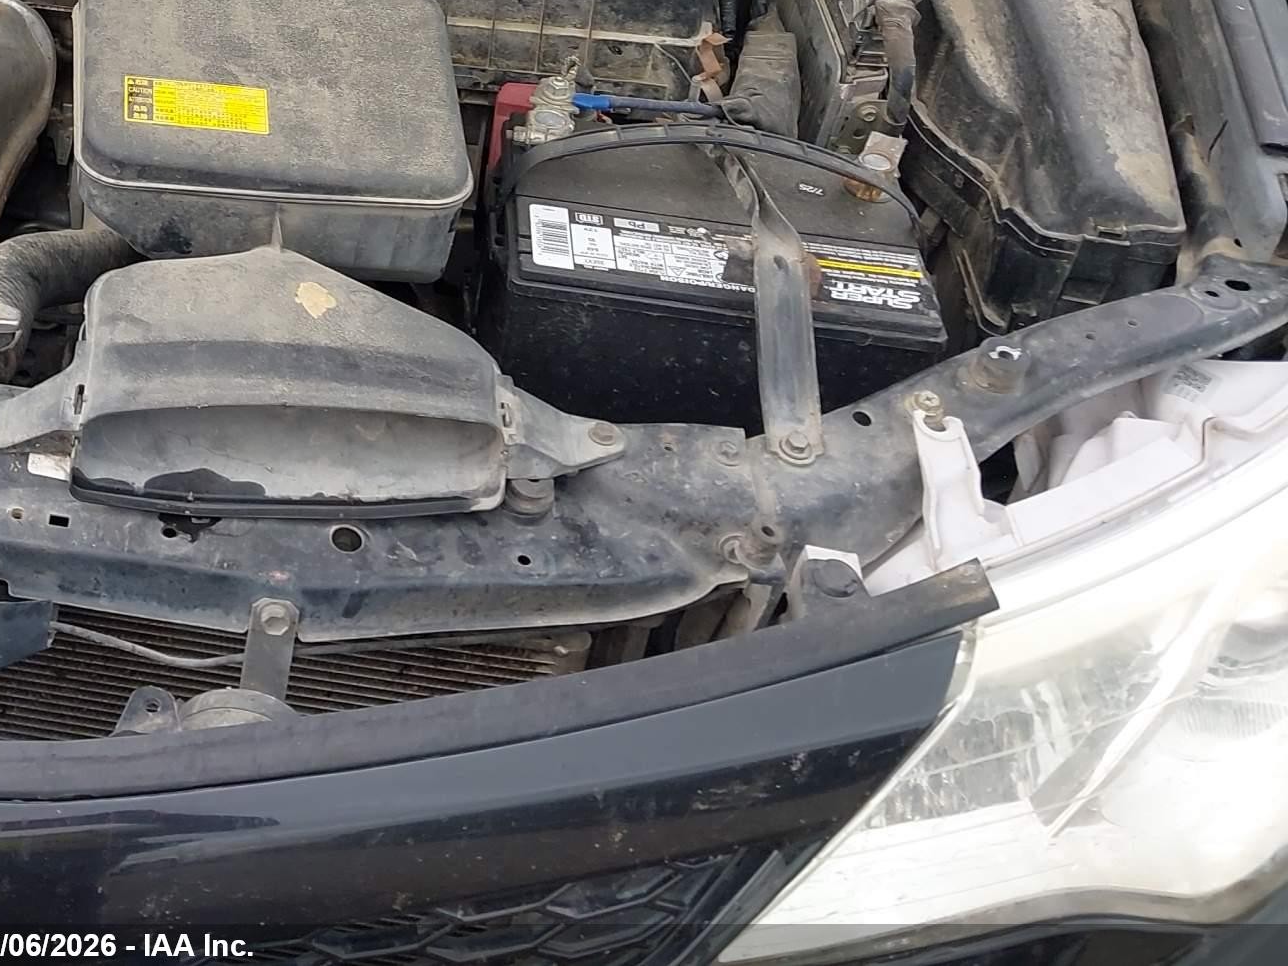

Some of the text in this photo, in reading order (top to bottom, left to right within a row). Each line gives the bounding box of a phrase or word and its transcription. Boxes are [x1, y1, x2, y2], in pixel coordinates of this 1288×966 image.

[627, 220, 645, 230] Pb
[829, 281, 921, 303] START
[831, 290, 913, 310] SUPER
